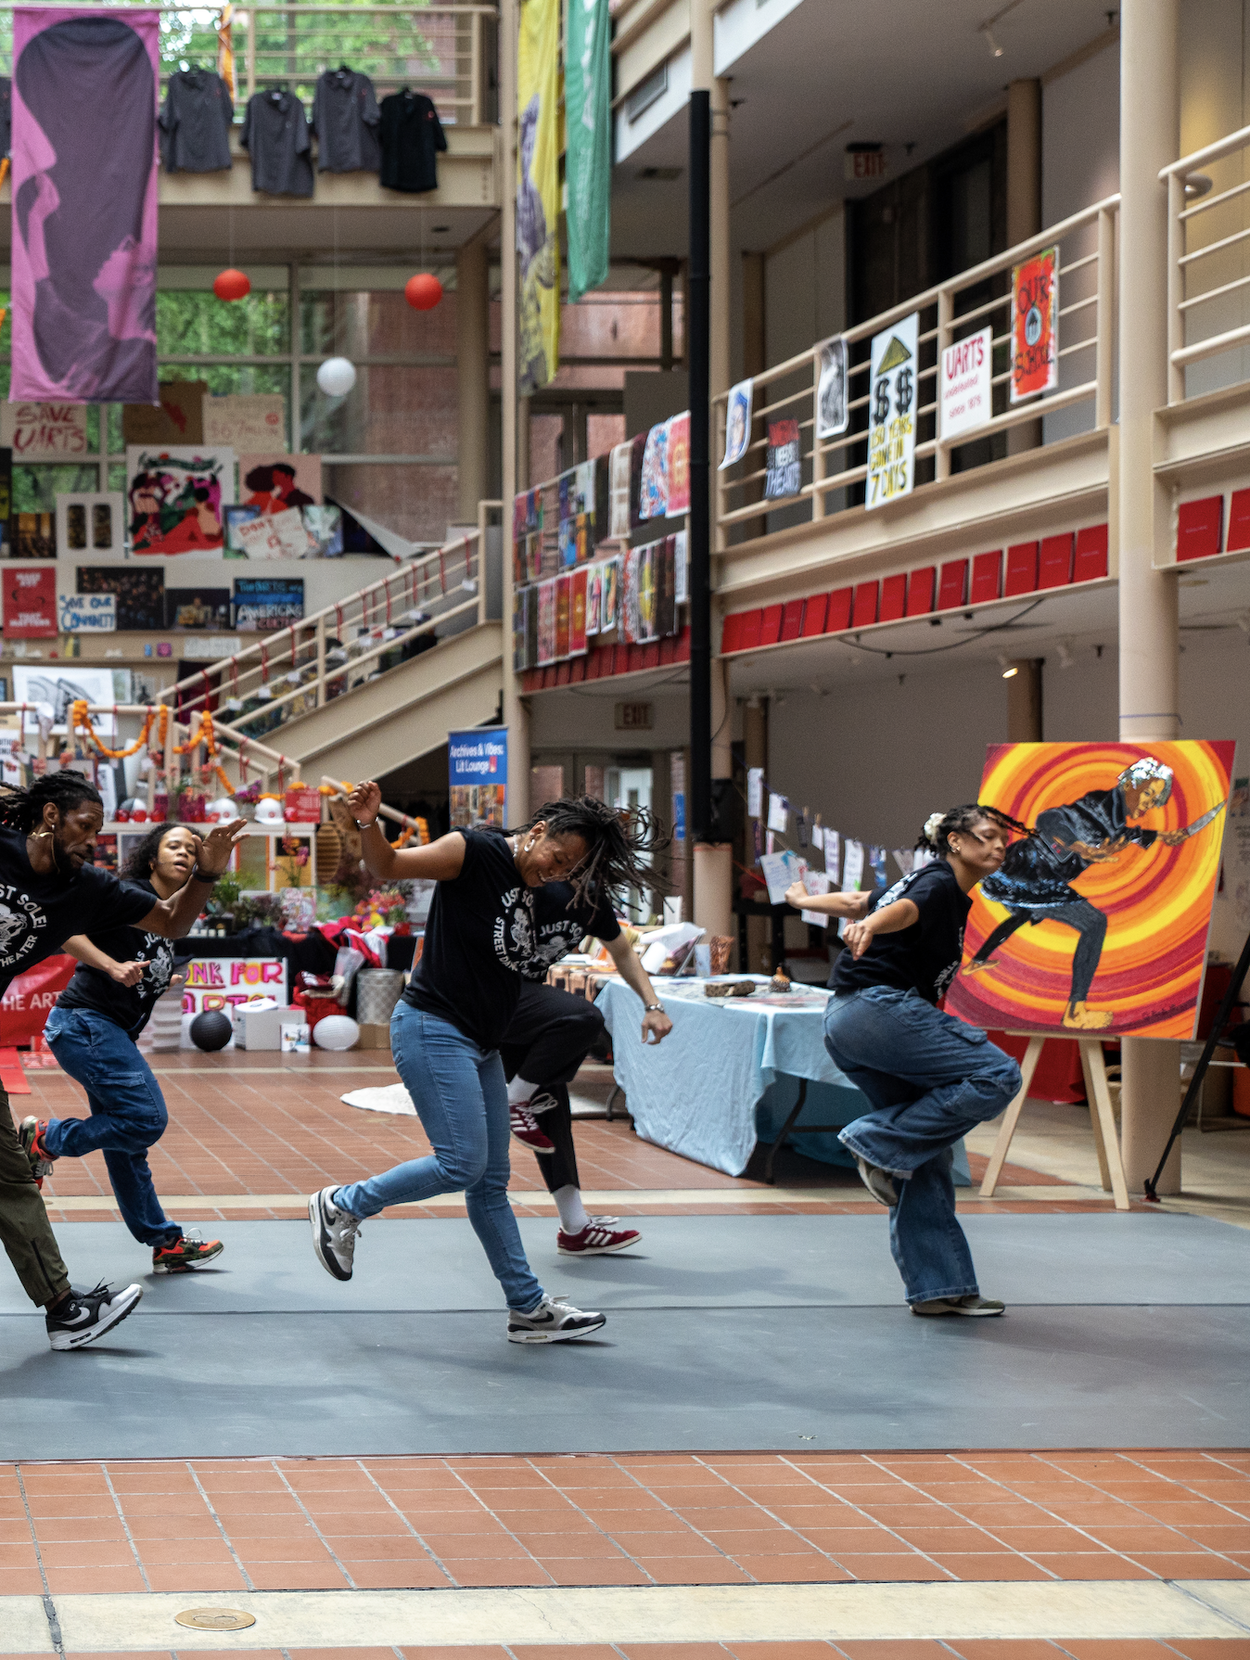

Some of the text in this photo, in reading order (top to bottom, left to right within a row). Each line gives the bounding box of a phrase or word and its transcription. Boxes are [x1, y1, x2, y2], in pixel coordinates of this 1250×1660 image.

[1017, 275, 1049, 315] OUR
[946, 336, 985, 381] UARTS
[15, 404, 77, 425] SAVE
[870, 474, 881, 505] 7
[59, 595, 112, 611] SAVE OUR
[623, 702, 648, 724] EXIT
[16, 894, 47, 929] SOLE!
[493, 916, 507, 955] STREET
[539, 920, 570, 937] JUST
[231, 962, 283, 985] FOR
[2, 990, 63, 1011] HE ART
